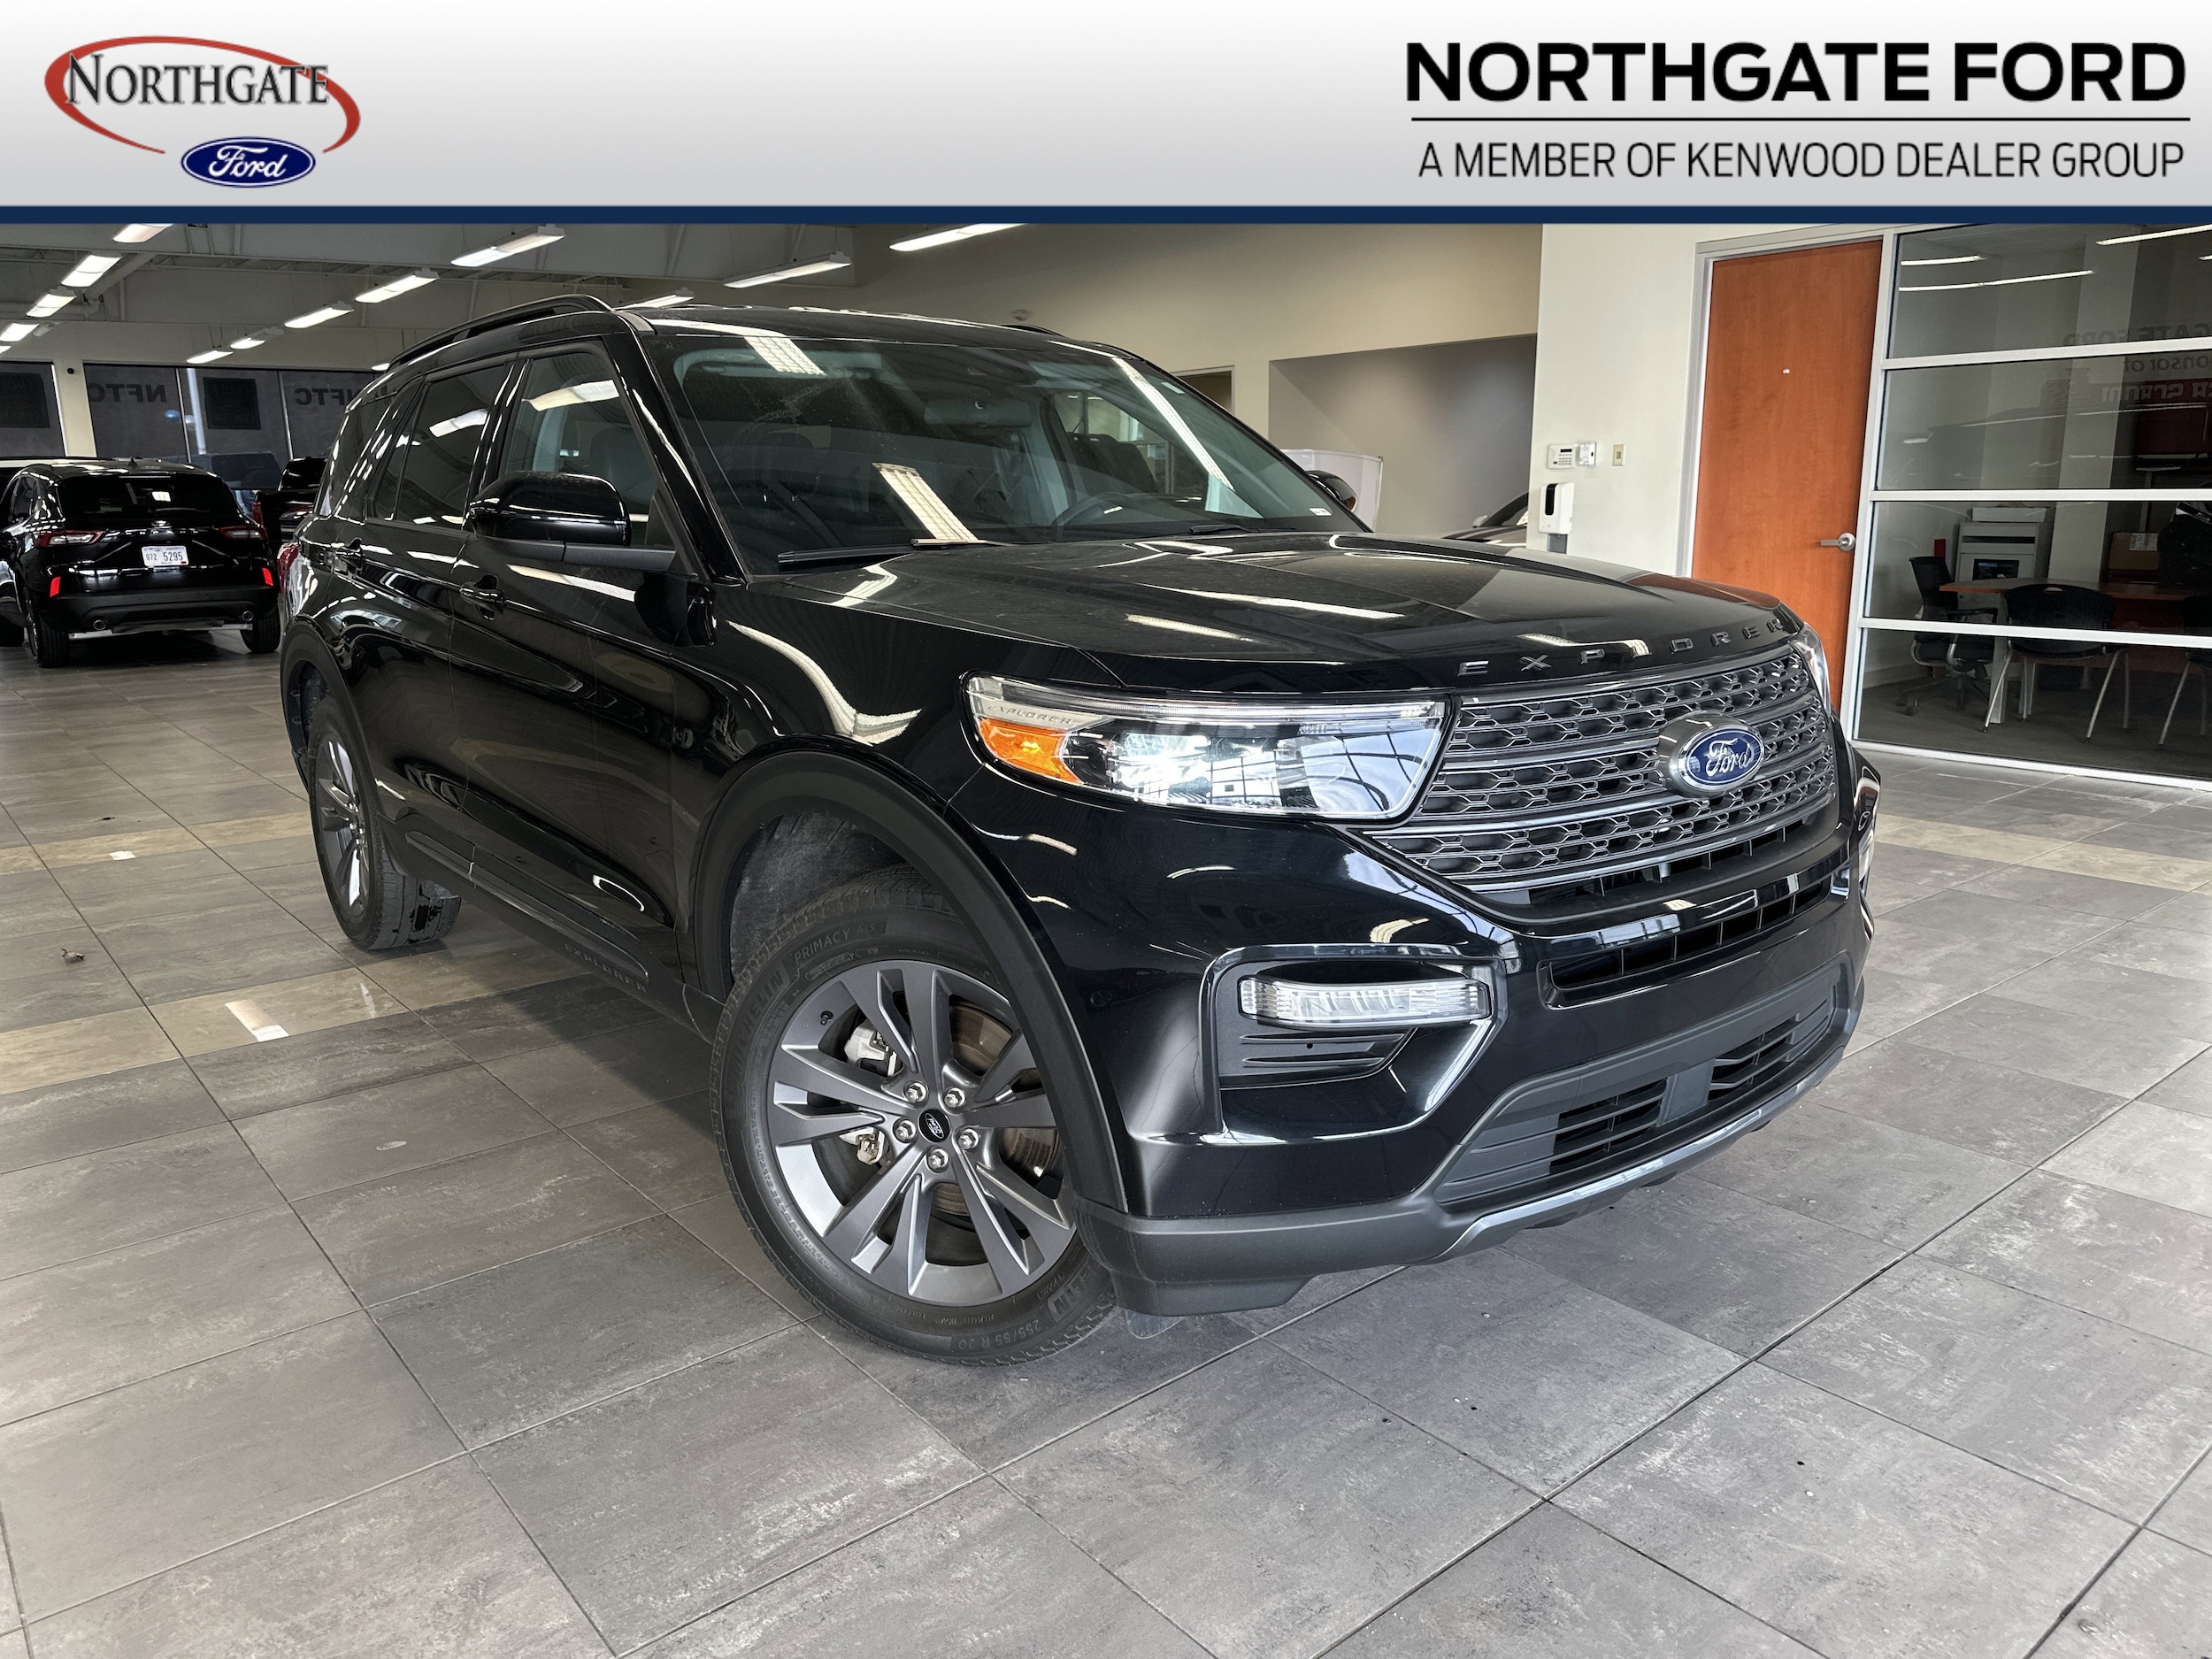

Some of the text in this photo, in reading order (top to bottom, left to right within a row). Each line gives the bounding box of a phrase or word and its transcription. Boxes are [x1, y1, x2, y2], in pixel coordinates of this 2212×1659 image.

[988, 704, 1072, 725] EXPLORER
[1704, 737, 1754, 777] Ford
[793, 926, 851, 965] PRIMACY
[564, 942, 648, 994] EXPLORER
[958, 1338, 979, 1351] 20
[980, 1337, 991, 1348] R
[995, 1318, 1041, 1348] 255/55
